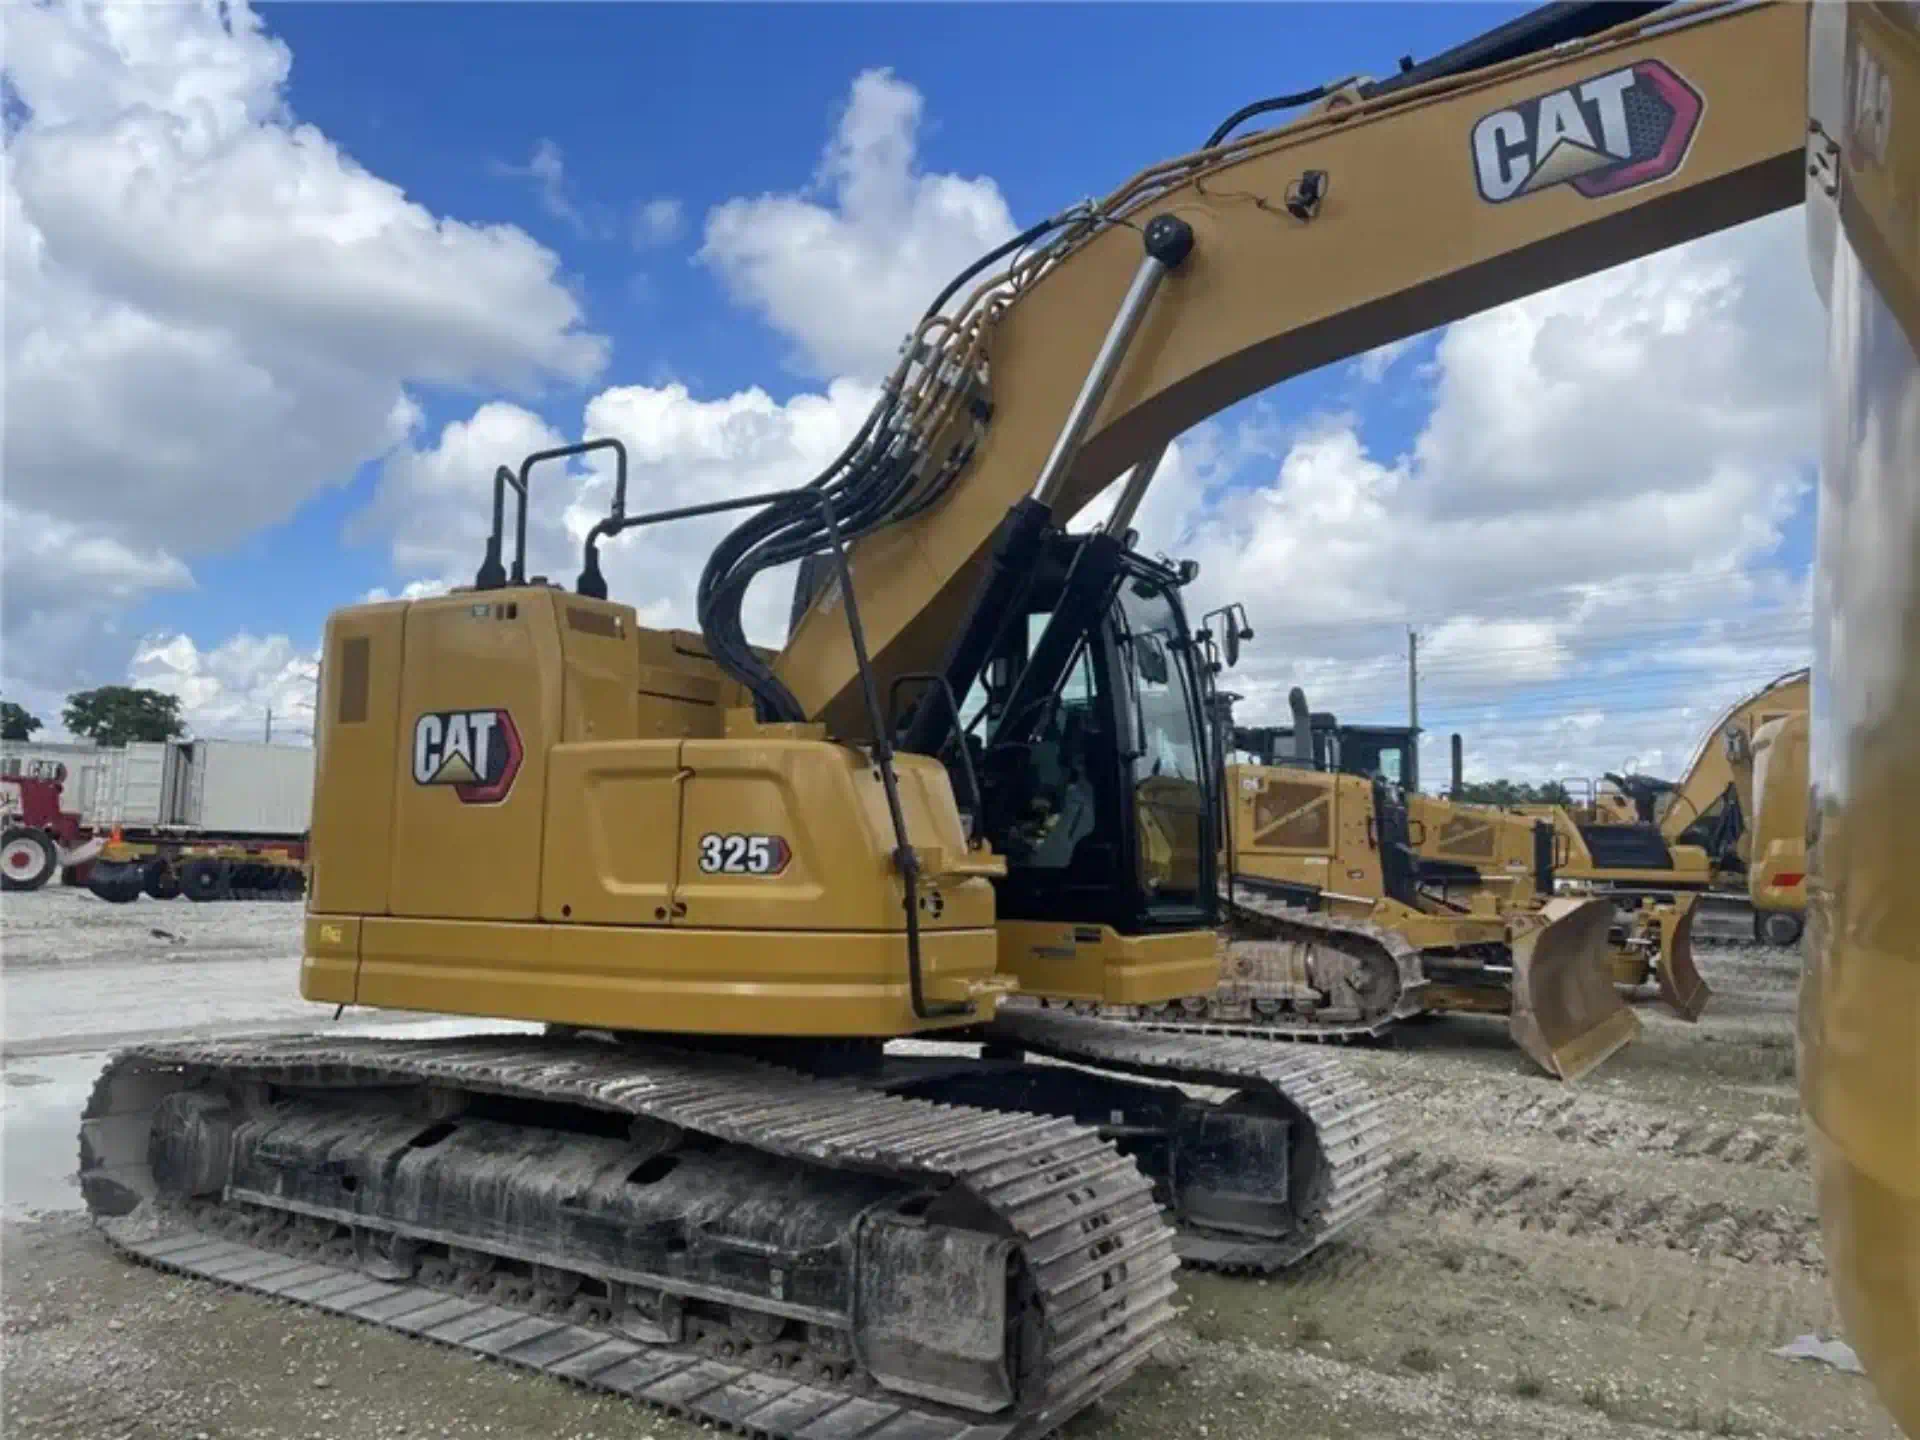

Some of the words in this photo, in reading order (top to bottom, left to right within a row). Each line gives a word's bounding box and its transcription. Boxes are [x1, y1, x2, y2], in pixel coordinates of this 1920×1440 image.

[1474, 68, 1635, 201] CAT
[413, 711, 497, 782] CAT
[699, 834, 769, 872] 325
